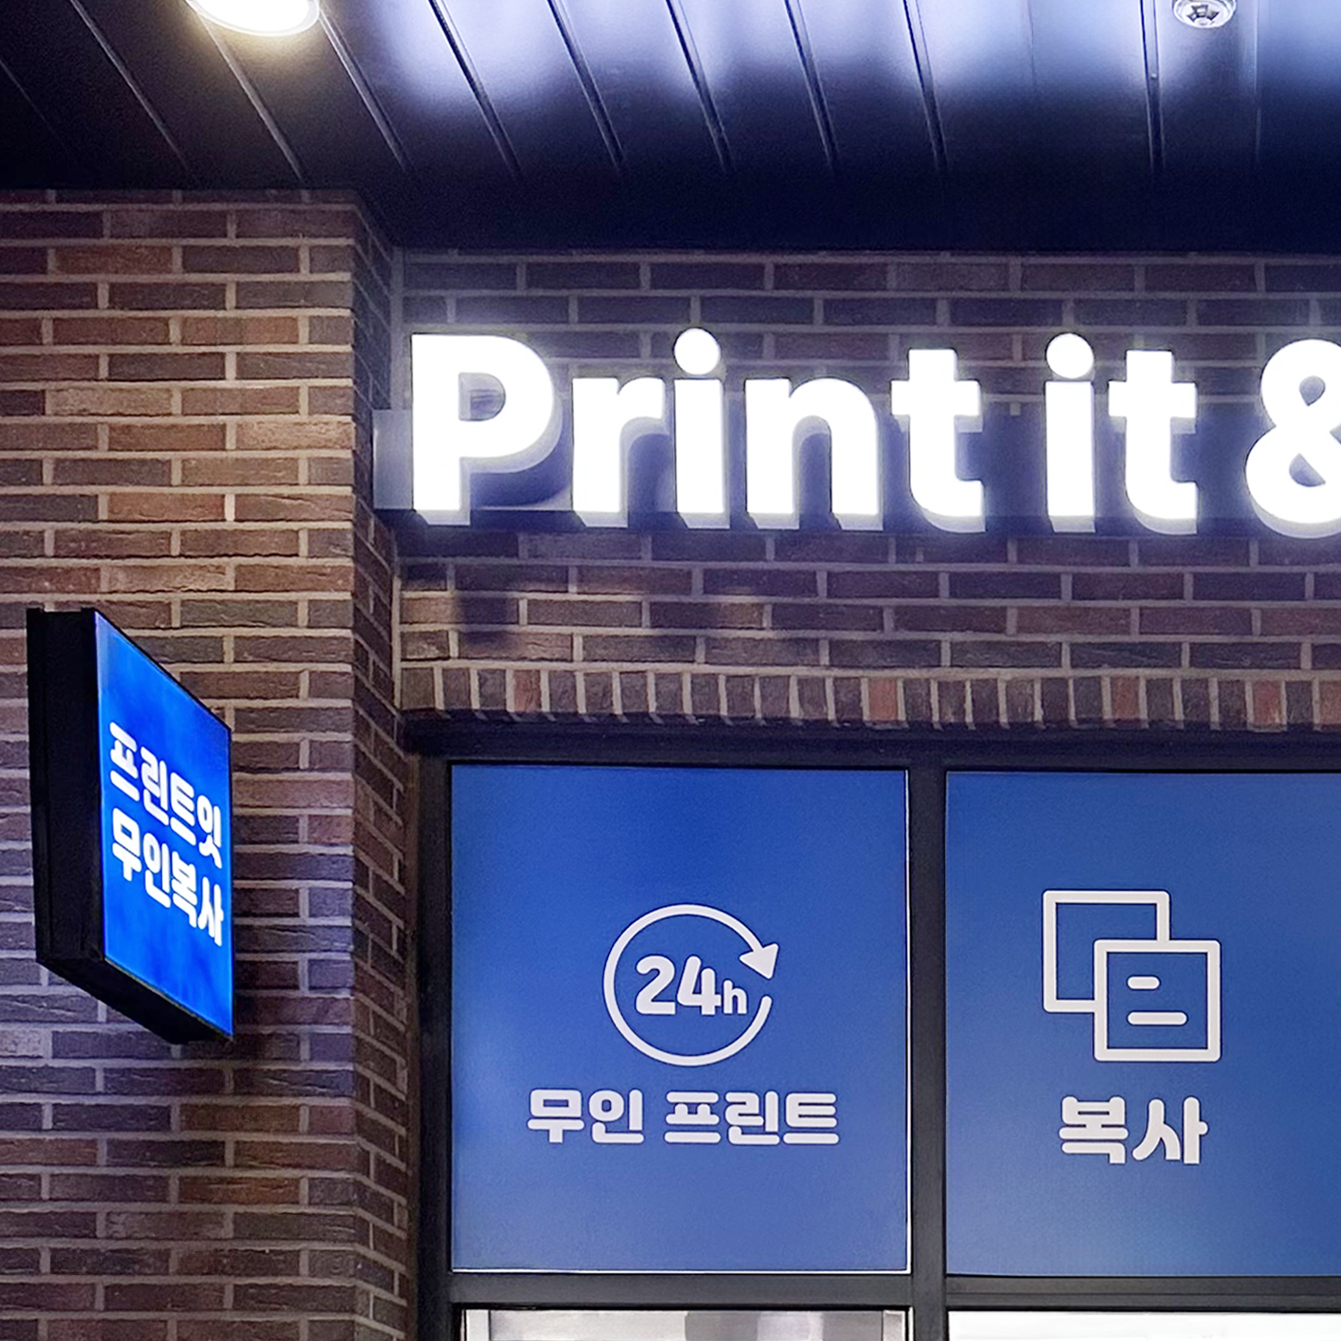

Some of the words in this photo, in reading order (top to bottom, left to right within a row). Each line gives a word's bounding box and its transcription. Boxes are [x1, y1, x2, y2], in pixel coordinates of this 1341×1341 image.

[411, 327, 987, 534] Print
[1045, 331, 1198, 534] it
[109, 721, 223, 868] 프린트잇
[111, 806, 223, 946] 무인복사
[635, 955, 748, 1015] 24h
[527, 1088, 645, 1143] 무인
[664, 1090, 840, 1145] 프린트
[1058, 1096, 1209, 1165] 복사
